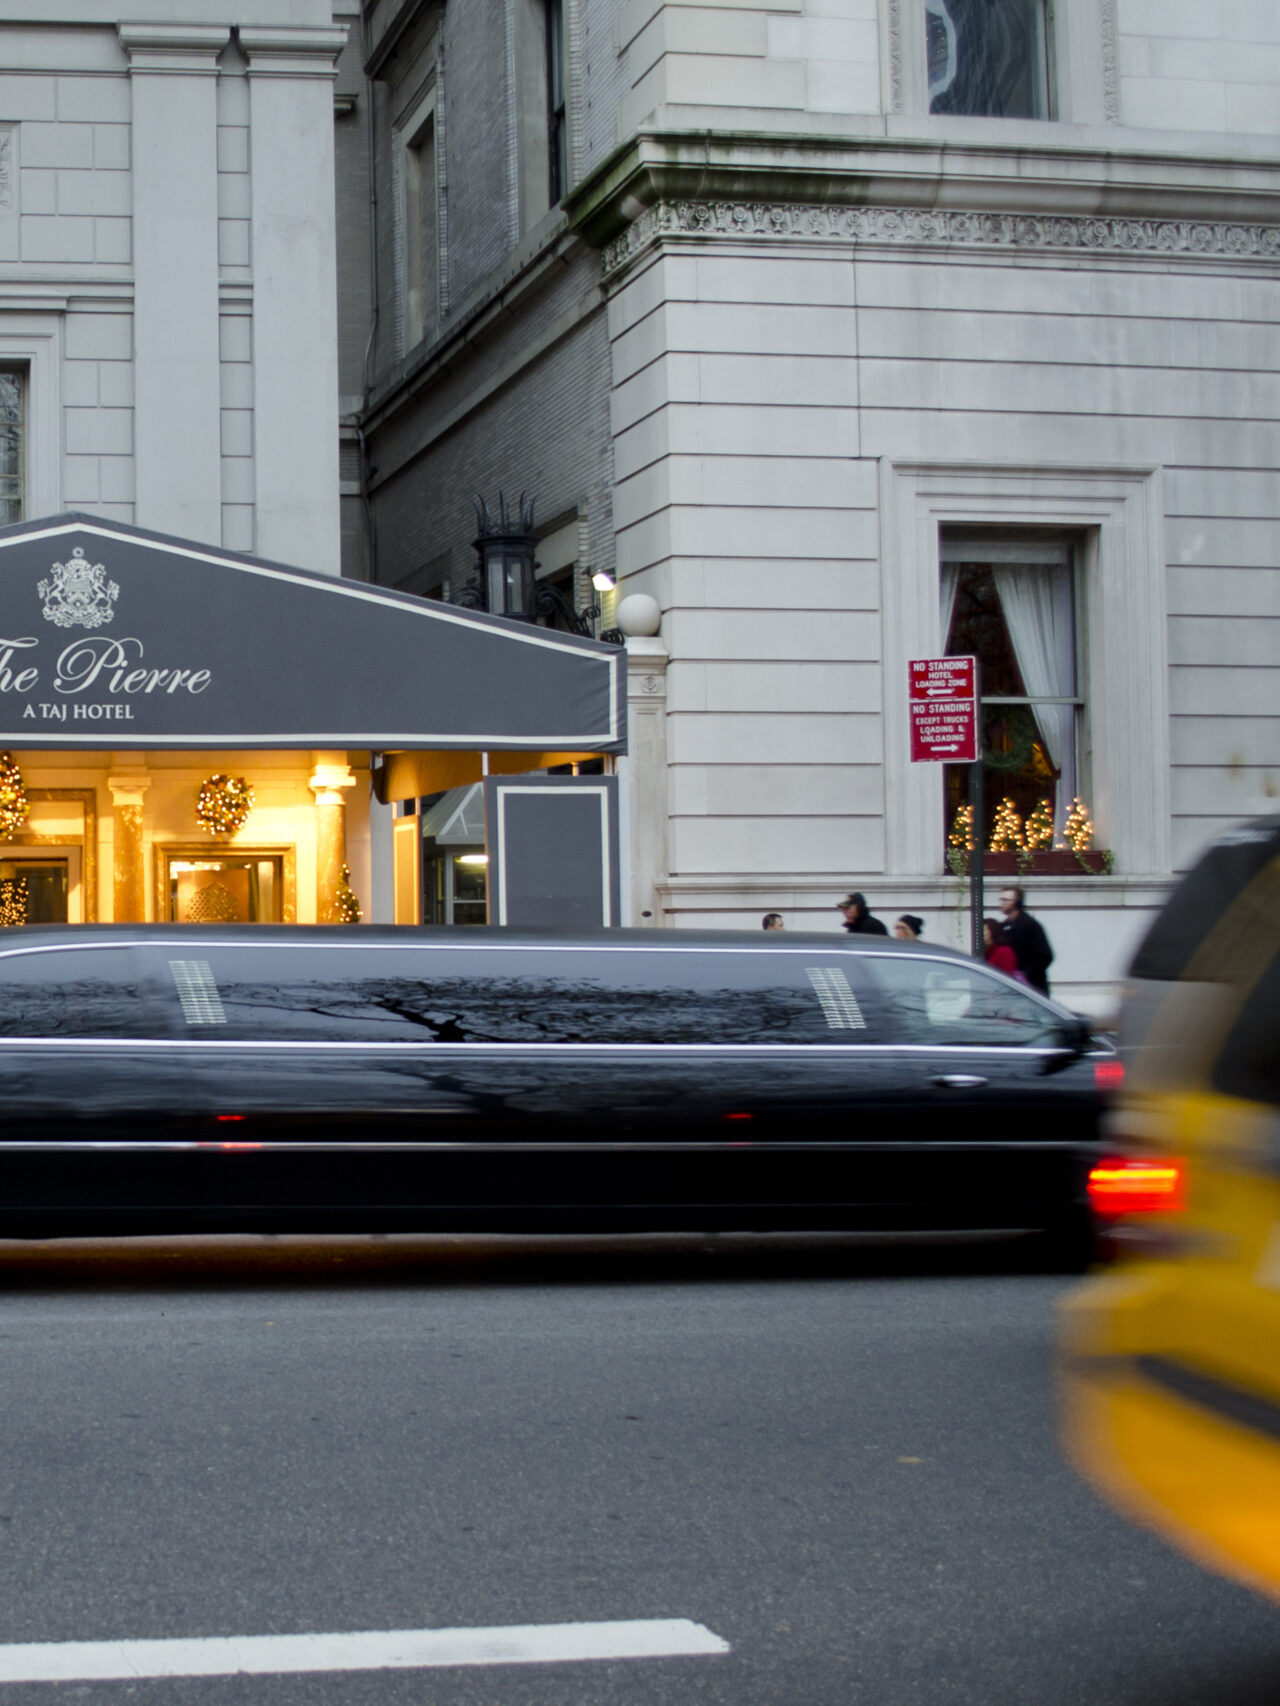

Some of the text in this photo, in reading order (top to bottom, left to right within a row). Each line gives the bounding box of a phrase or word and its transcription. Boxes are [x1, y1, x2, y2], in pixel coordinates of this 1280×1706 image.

[53, 636, 212, 694] Pierre
[913, 661, 968, 672] NO STANDING
[915, 680, 946, 688] LOADING
[22, 704, 134, 722] A TAJ HOTEL
[912, 703, 970, 714] NO STANDING
[915, 717, 940, 725] EXCEPT
[920, 726, 953, 734] LOADING
[920, 734, 965, 743] UNLOADING
